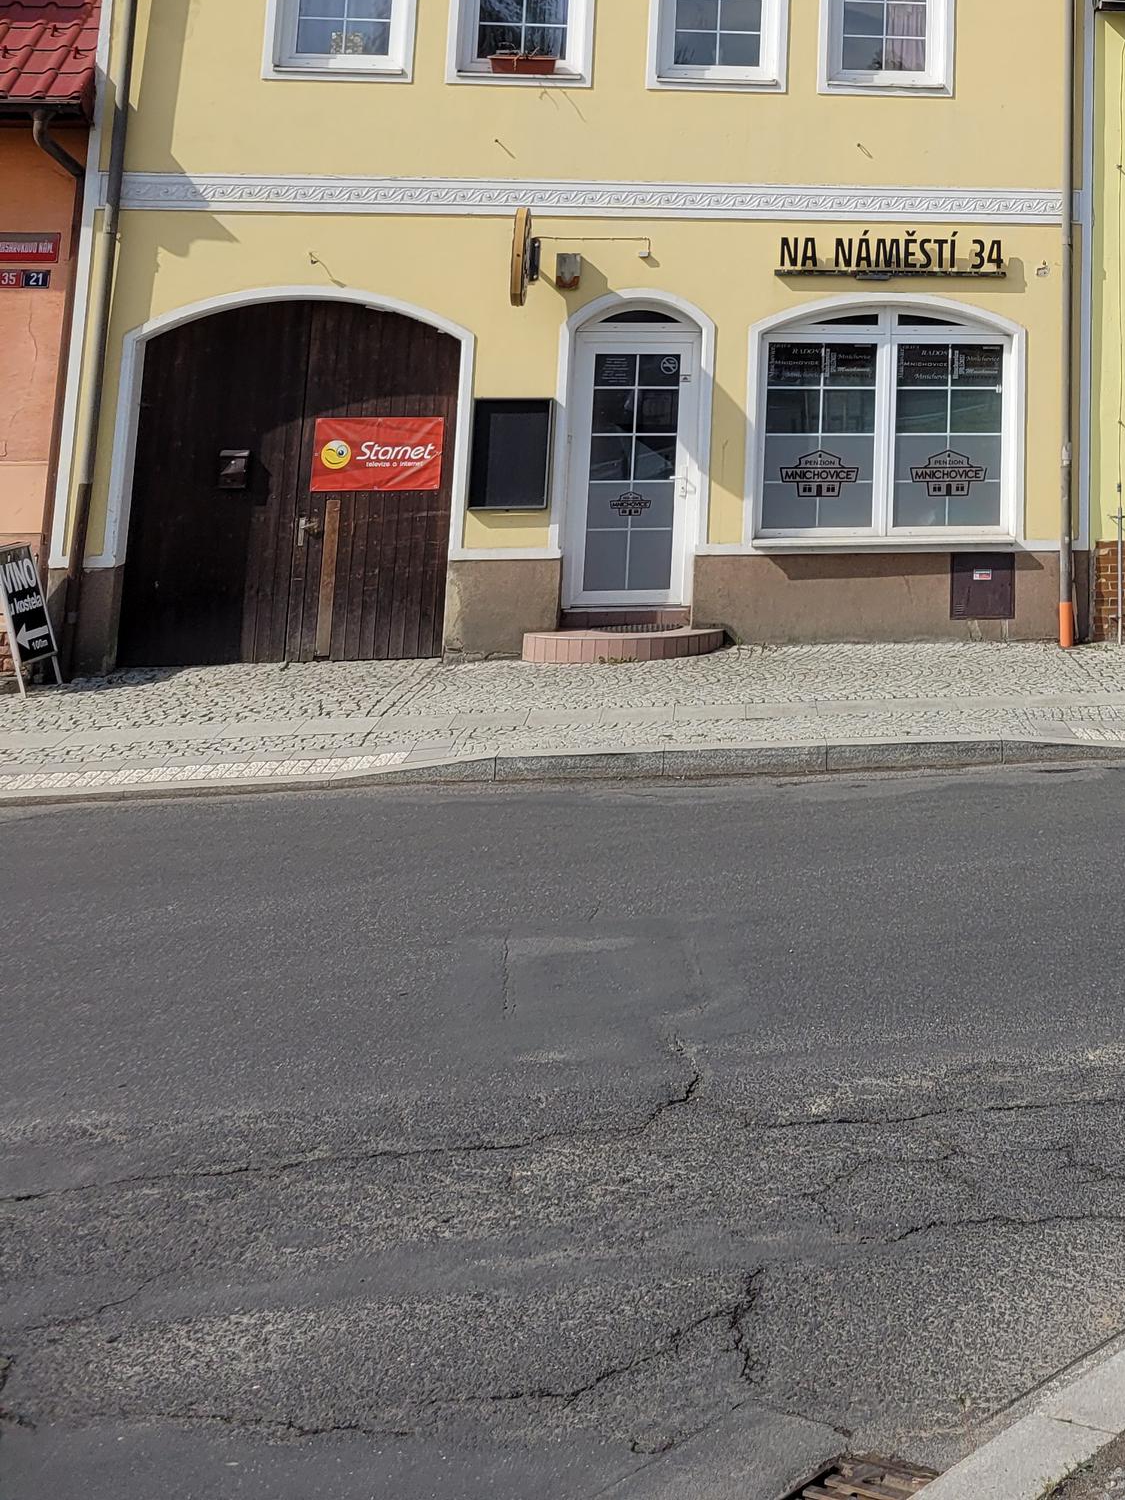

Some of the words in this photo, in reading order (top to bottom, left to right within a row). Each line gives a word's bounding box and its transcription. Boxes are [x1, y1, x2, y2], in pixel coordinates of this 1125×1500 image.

[780, 237, 818, 267] NA
[834, 230, 959, 269] NÁMĚSTÍ
[971, 239, 1004, 269] 34
[1, 272, 17, 285] 35
[29, 272, 43, 286] 21
[356, 442, 435, 460] Starnet
[784, 469, 854, 480] MNICHOVICE
[914, 469, 981, 480] MNICHOVICE
[0, 554, 37, 595] VÍNO
[14, 592, 43, 615] kostela
